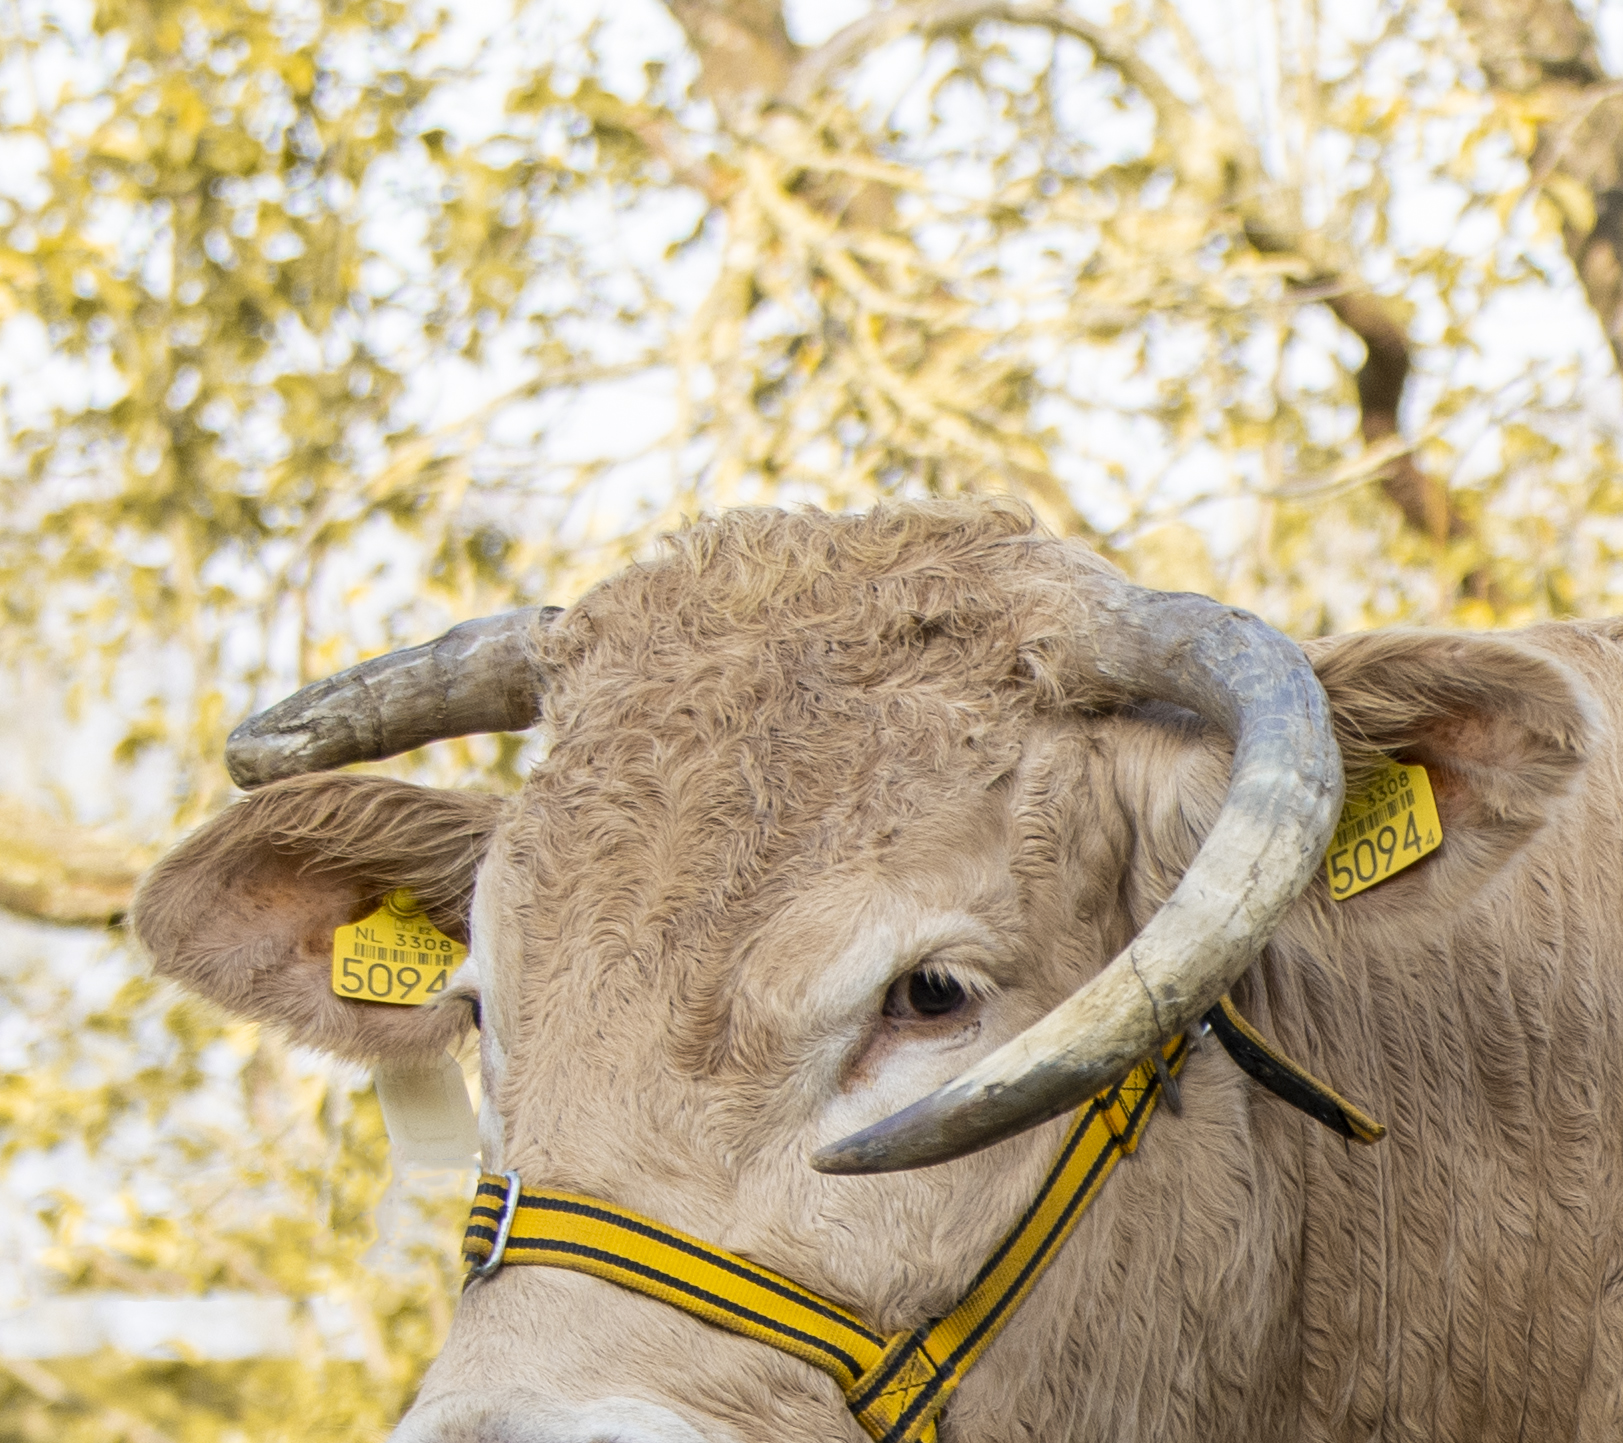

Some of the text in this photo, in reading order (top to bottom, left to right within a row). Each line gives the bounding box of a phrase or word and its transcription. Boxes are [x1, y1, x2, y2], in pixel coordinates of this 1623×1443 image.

[1365, 770, 1410, 809] 3308
[1330, 810, 1422, 894] 5094
[355, 926, 452, 952] NL 3308
[341, 957, 447, 999] 5094
